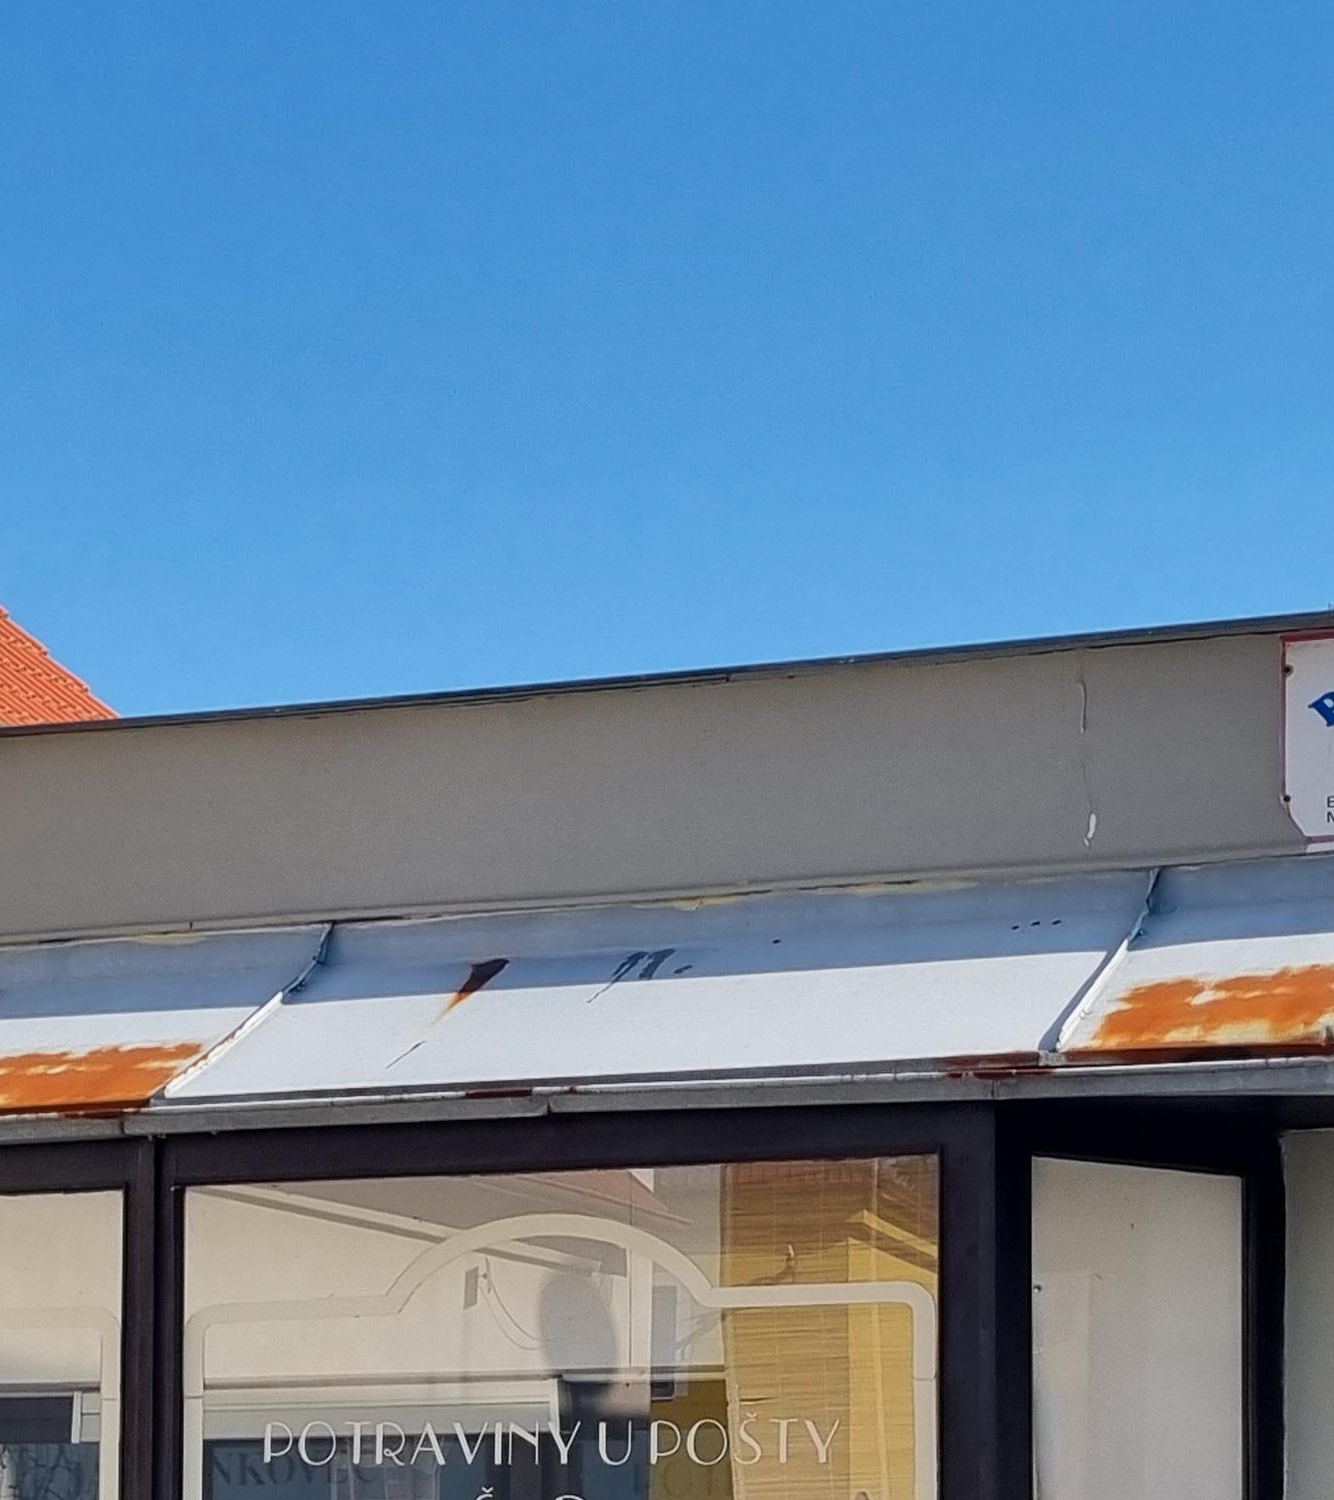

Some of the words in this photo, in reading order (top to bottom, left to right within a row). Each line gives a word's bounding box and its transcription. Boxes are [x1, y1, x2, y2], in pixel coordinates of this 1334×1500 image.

[262, 1419, 581, 1466] POTRAVINY
[598, 1420, 635, 1465] U
[649, 1411, 841, 1467] POŠTY
